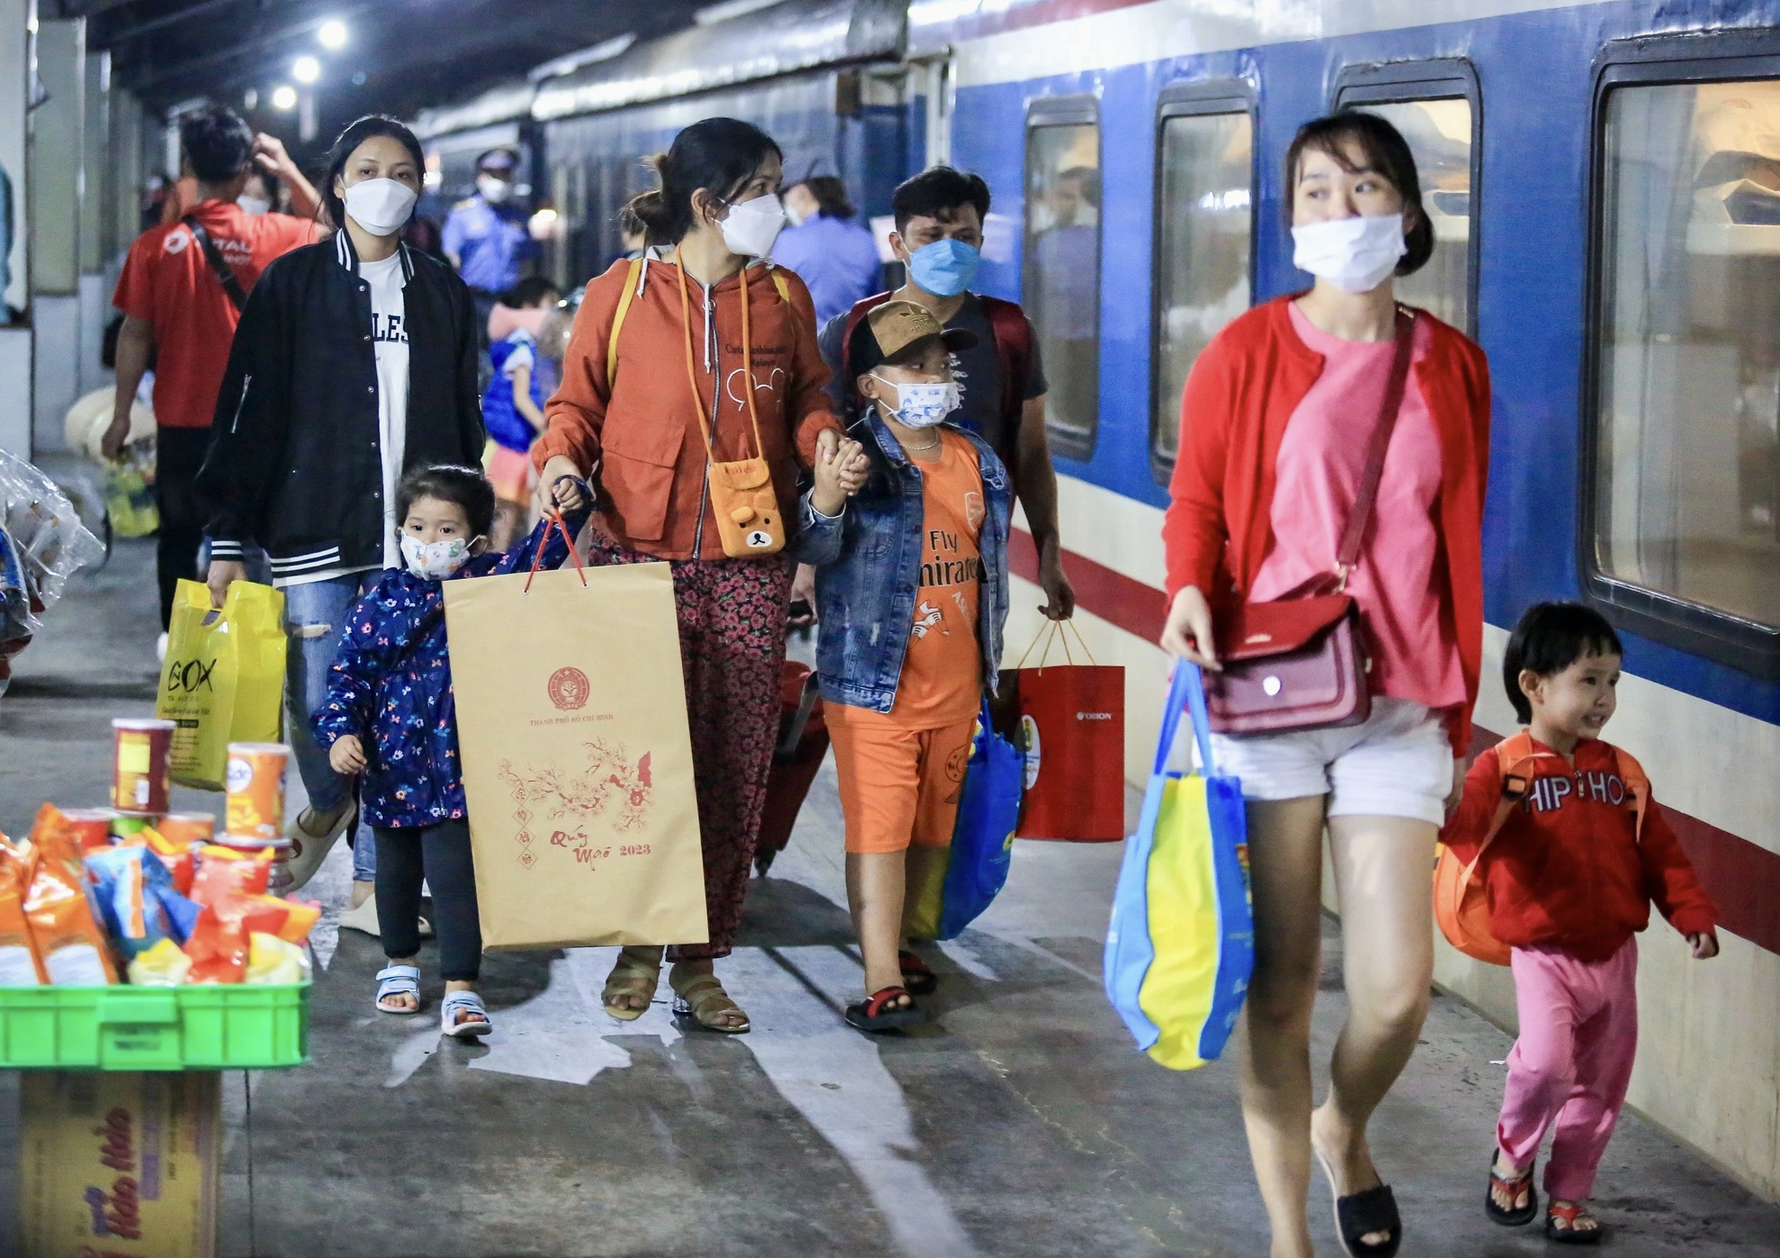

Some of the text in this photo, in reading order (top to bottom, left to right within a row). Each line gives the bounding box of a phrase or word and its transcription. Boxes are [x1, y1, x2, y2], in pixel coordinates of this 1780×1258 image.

[372, 312, 409, 345] LE
[929, 529, 958, 553] Fly
[1588, 770, 1624, 806] HO
[620, 844, 651, 856] 2023
